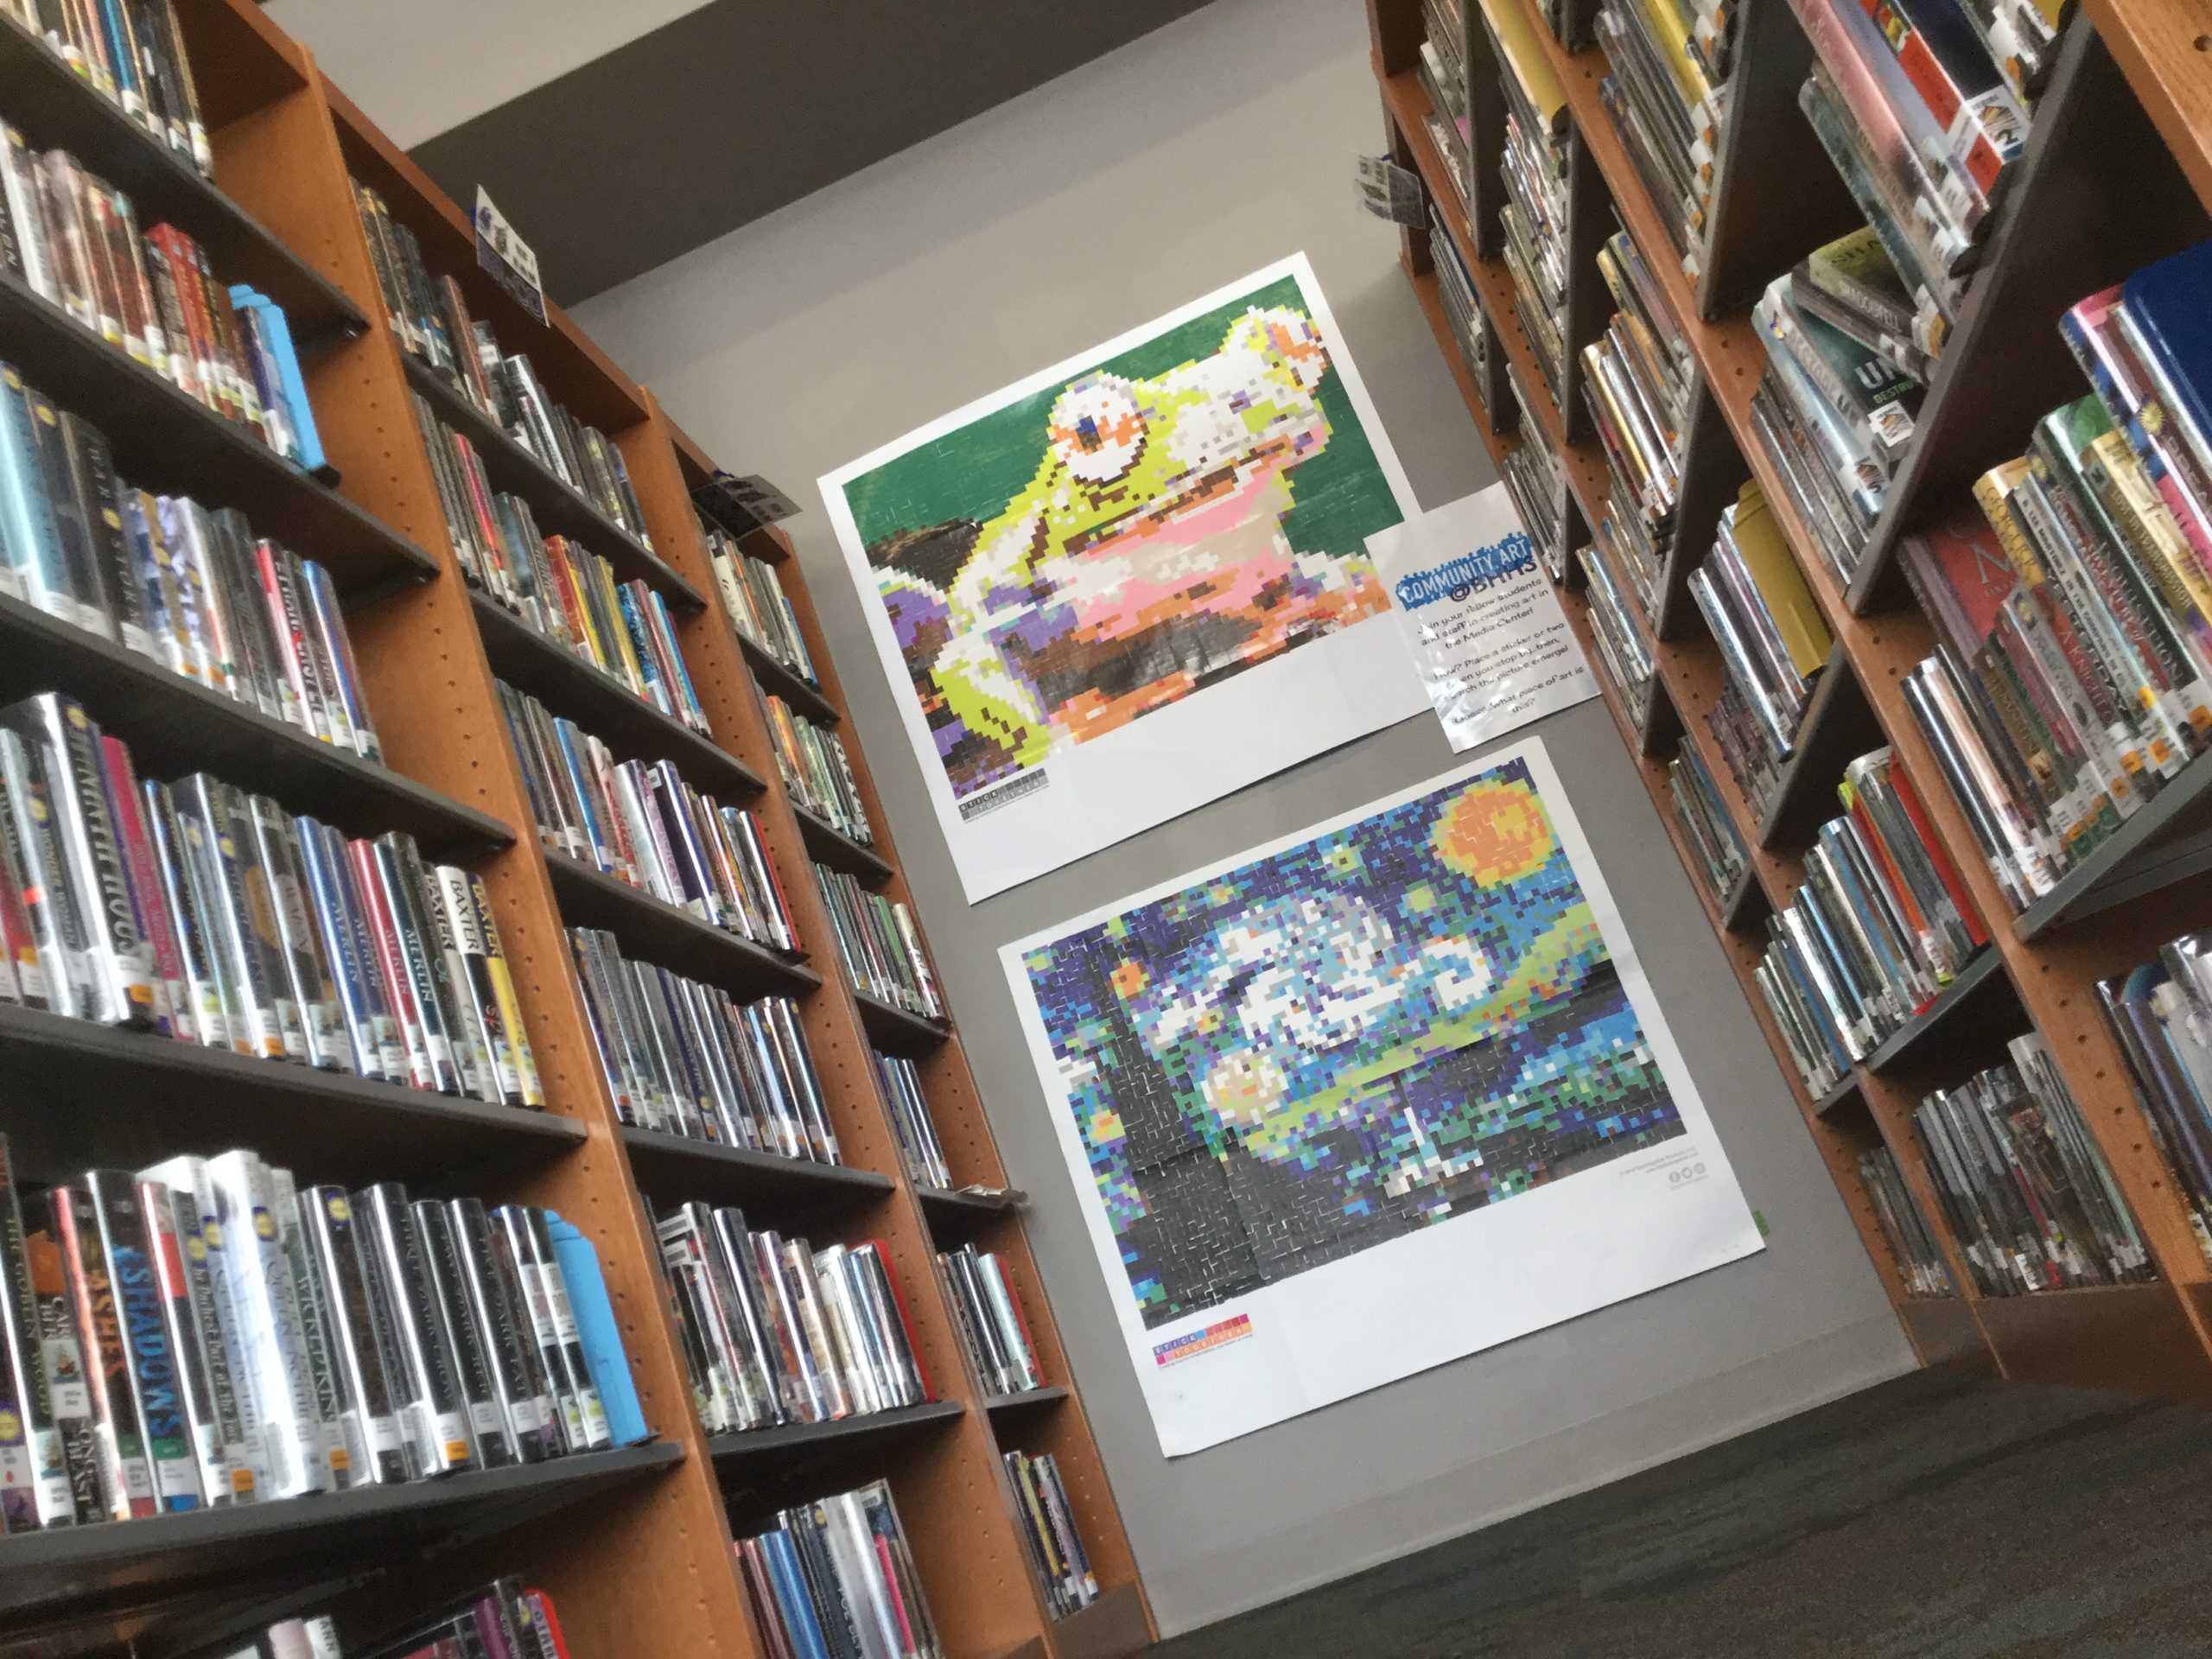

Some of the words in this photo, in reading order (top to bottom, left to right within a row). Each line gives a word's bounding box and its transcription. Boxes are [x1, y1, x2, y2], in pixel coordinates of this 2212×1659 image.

[1400, 551, 1497, 605] COMMUNITY
[1496, 538, 1530, 566] ART
[1440, 610, 1465, 626] your
[1464, 595, 1497, 614] fellow
[1495, 576, 1543, 602] students
[1446, 554, 1539, 604] @BHHS
[1440, 620, 1469, 639] staff
[1465, 615, 1478, 627] in
[1478, 599, 1521, 623] creating
[1520, 592, 1537, 605] art
[1536, 587, 1549, 598] in
[1443, 636, 1463, 650] the
[1461, 621, 1496, 643] Media
[1463, 651, 1491, 669] Place
[1532, 629, 1545, 639] or
[1545, 620, 1565, 634] two
[2041, 567, 2131, 712] YESTERDAY
[2094, 540, 2183, 683] INQUISITION
[1473, 664, 1494, 678] you
[1494, 652, 1518, 669] stop
[1494, 660, 1530, 682] picture
[1529, 644, 1570, 667] emerge!
[1542, 673, 1560, 687] of
[1557, 669, 1573, 682] art
[1573, 664, 1585, 676] is
[2065, 645, 2110, 707] KNIGHT
[1510, 696, 1537, 714] this?
[36, 826, 66, 889] WONDER
[99, 867, 147, 961] HOUS
[328, 899, 361, 985] MERLIN
[423, 871, 456, 951] BAXTER
[448, 876, 480, 952] BAXTER
[469, 880, 502, 957] BAXTER
[352, 916, 380, 988] MERLIN
[404, 926, 435, 1005] MERLIN
[12, 1261, 38, 1341] GOBLIN
[29, 1350, 53, 1416] WOOD
[118, 1262, 185, 1441] SHADOWS
[294, 1272, 326, 1365] WICKED
[1175, 1326, 1243, 1357] TOGETHER
